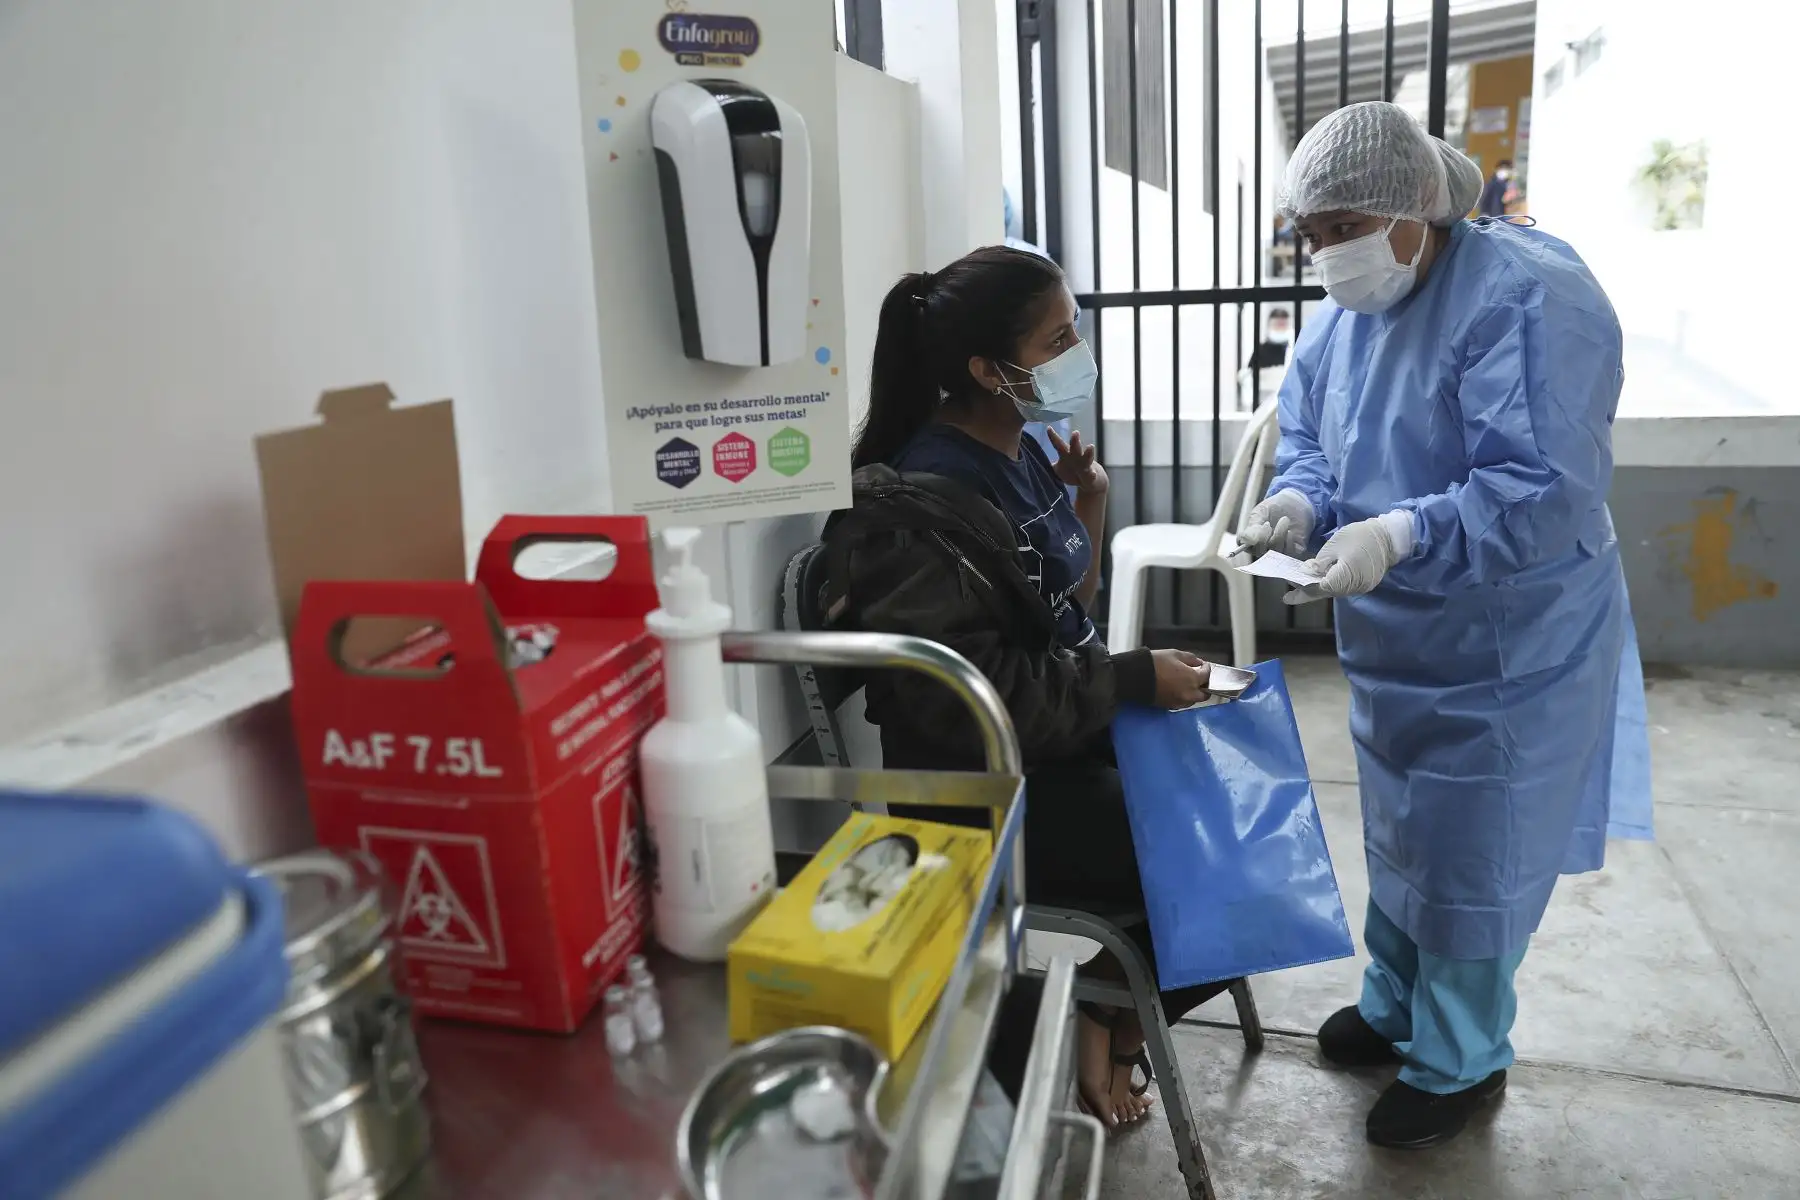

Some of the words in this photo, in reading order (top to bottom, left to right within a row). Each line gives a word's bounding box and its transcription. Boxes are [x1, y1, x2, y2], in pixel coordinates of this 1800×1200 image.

[626, 402, 683, 420] ¡Apóyalo
[685, 403, 701, 413] en
[703, 401, 718, 411] su
[720, 395, 781, 410] desarrollo
[655, 420, 683, 433] para
[685, 419, 709, 430] que
[711, 414, 742, 427] logre
[744, 413, 765, 423] sus
[767, 408, 806, 421] metas!
[717, 441, 750, 451] SISTEMA
[323, 728, 395, 770] A&F
[405, 734, 504, 777] 7.5L
